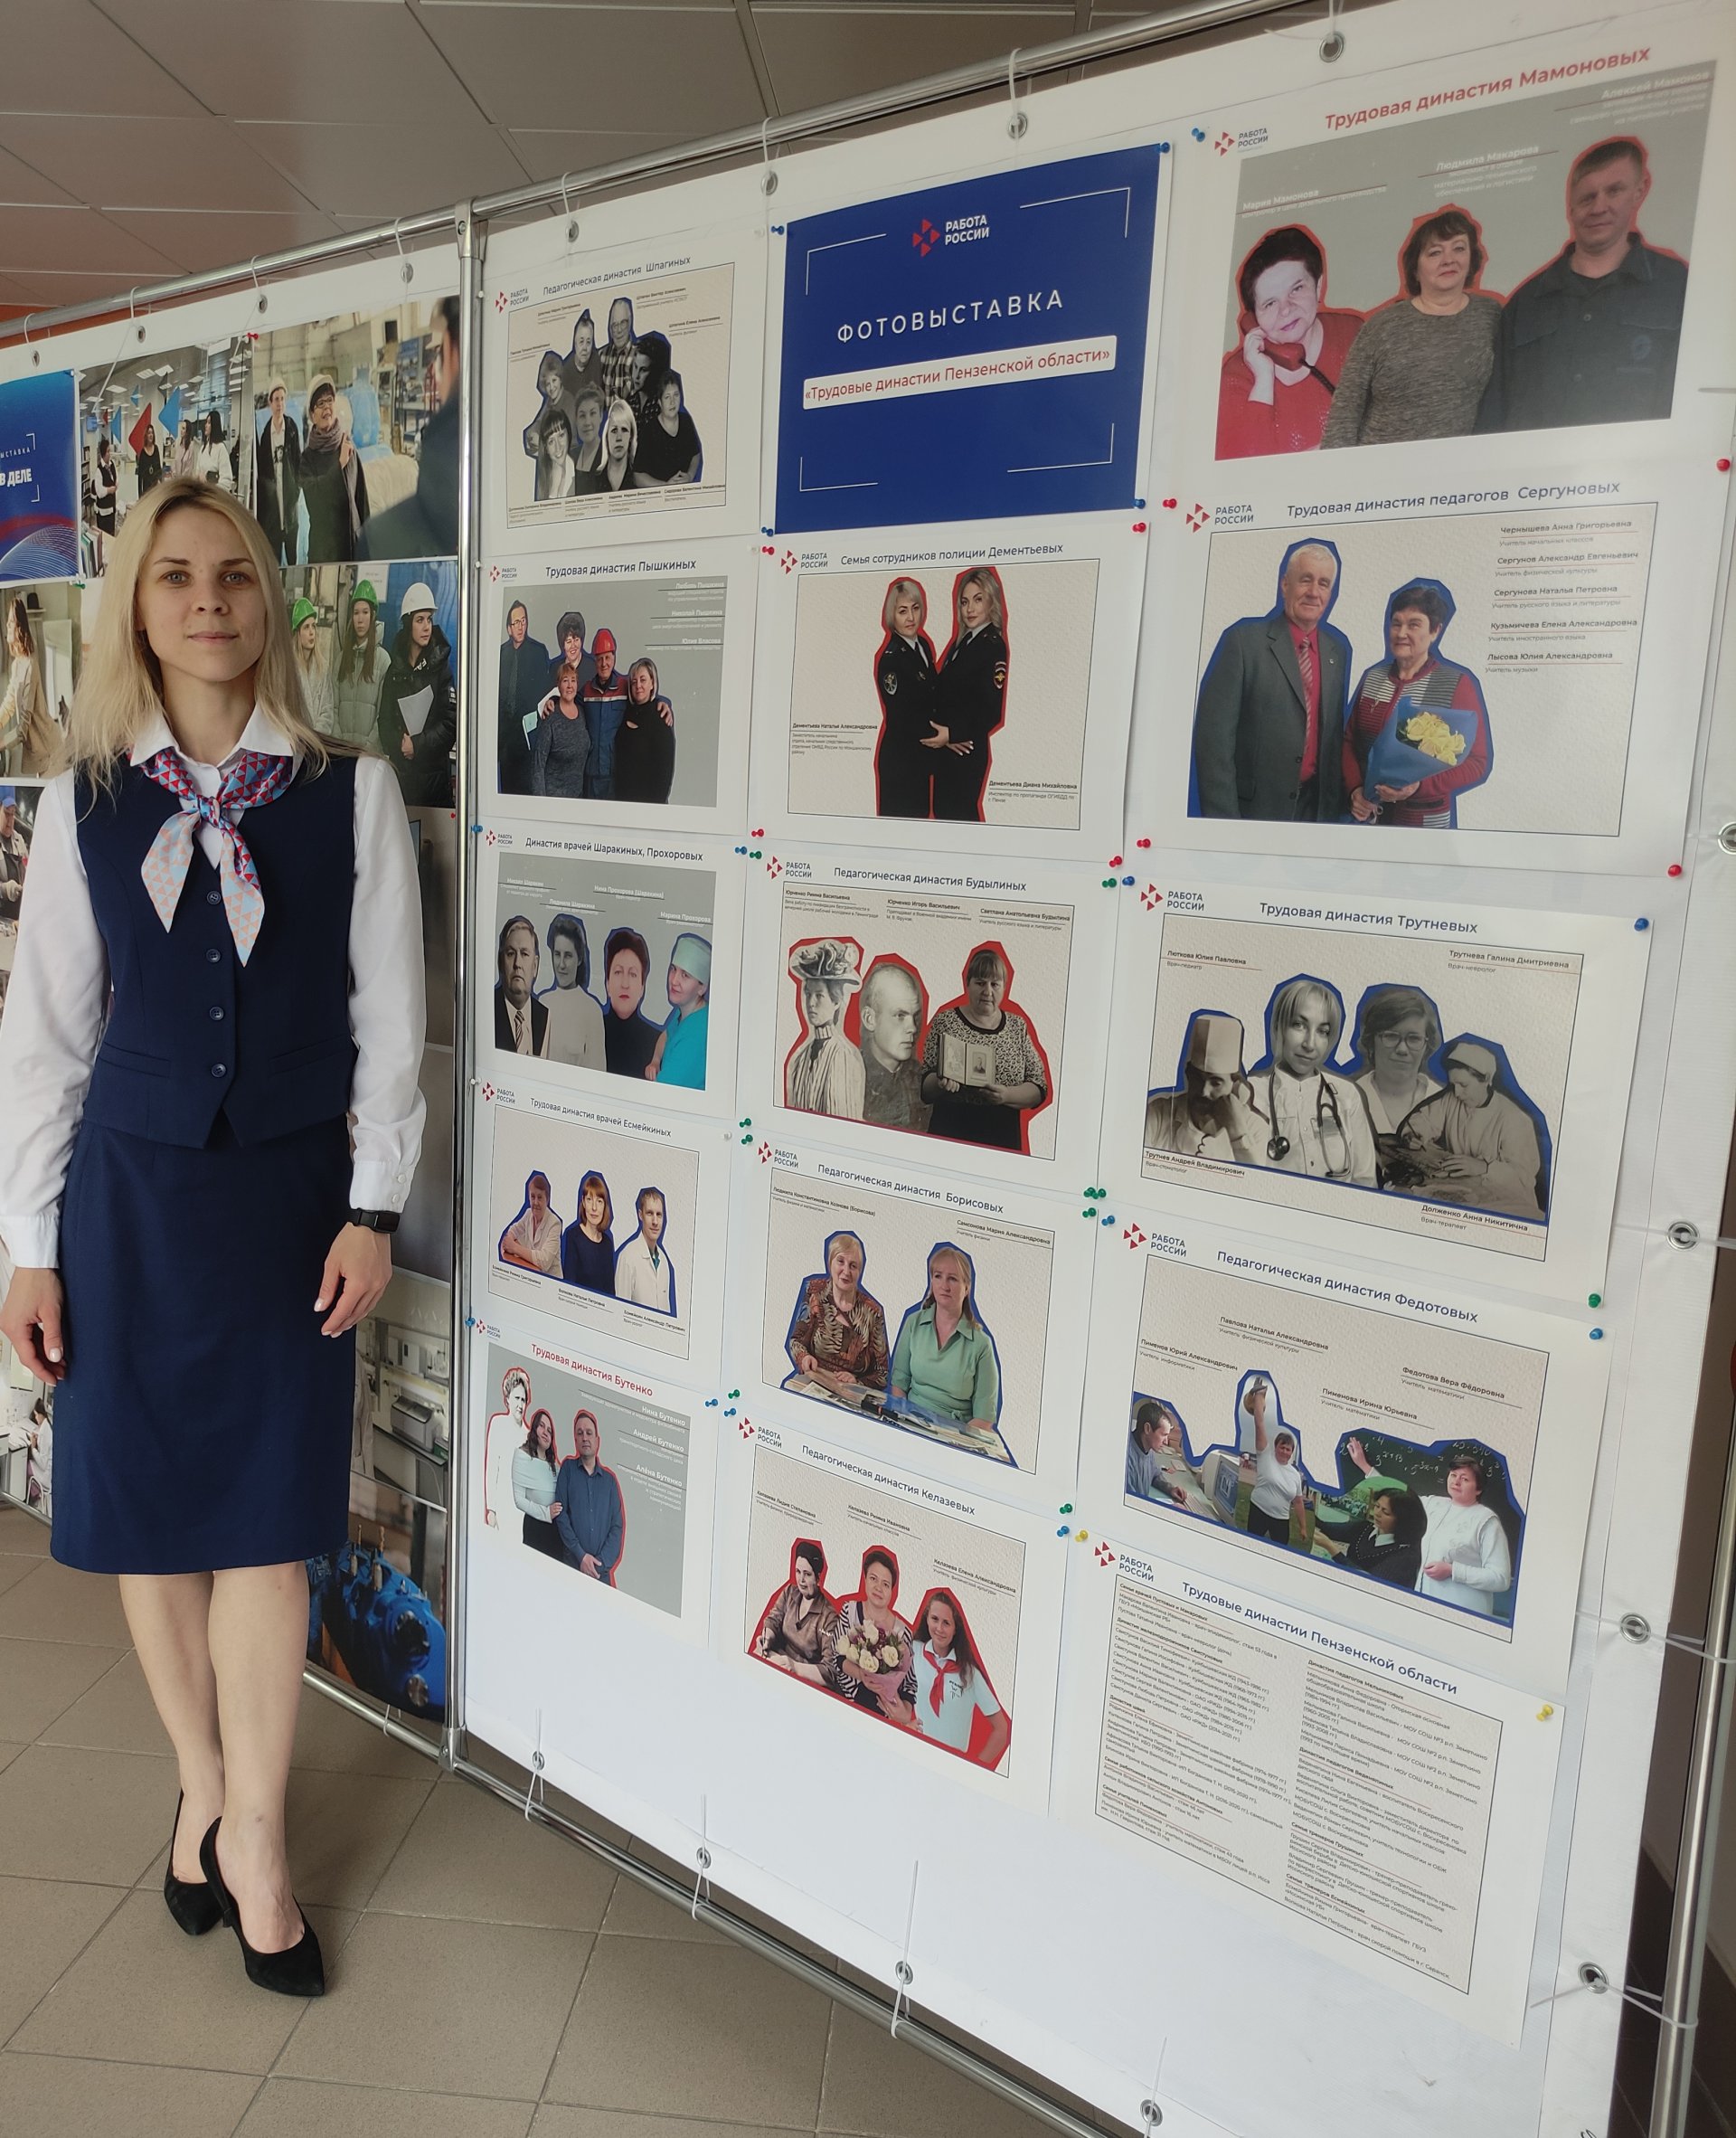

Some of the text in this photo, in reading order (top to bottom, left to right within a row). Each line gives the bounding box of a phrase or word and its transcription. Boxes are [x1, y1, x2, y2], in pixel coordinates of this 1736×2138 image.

[1326, 47, 1651, 129] Трудовая династия Мамоновых
[1238, 136, 1268, 148] РОССИИ
[1239, 128, 1267, 139] РАБОТА
[946, 214, 987, 232] РАБОТА
[945, 228, 989, 245] РОССИИ
[543, 257, 691, 296] Педагогическая династия Шпагиных
[510, 296, 529, 307] РОССИИ
[511, 289, 528, 298] РАБОТА
[837, 290, 1063, 343] ФОТОВЫСТАВКА
[805, 349, 1109, 401] «Трудовые династии Пензенской области»
[7, 468, 33, 487] ДЕЛЕ
[1288, 483, 1620, 518] Трудовая династия педагогов Сергуновых
[1216, 505, 1252, 515] РАБОТА
[1214, 515, 1253, 525] РОССИИ
[1501, 525, 1550, 534] Чернышева
[1576, 521, 1631, 530] Григорьевна
[802, 553, 827, 561] РАБОТА
[841, 544, 1062, 565] Семья сотрудников полиции Дементьевых
[1497, 552, 1638, 564] Сергунов Александр Евгеньевич
[546, 560, 696, 579] Трудовая династия Пышкиных
[801, 561, 828, 569] РОССИИ
[1495, 586, 1617, 597] Сергунова Наталья Петровна
[1491, 622, 1539, 630] Кузьмичева
[1569, 620, 1637, 628] Александровна
[1545, 652, 1612, 661] Александровна
[525, 837, 703, 861] Династия врачей Шаракиных, Прохоровых
[786, 870, 812, 878] РОССИИ
[787, 862, 811, 870] РАБОТА
[834, 868, 1026, 892] Педагогическая династия Будылиных
[1168, 891, 1203, 902] РАБОТА
[1167, 901, 1204, 911] РОССИИ
[1260, 903, 1477, 934] Трудовая династия Трутневых
[1167, 951, 1194, 959] Люткова
[1215, 956, 1246, 964] Павловна
[1449, 950, 1569, 969] Трутнева Галина Дмитриевна
[497, 1088, 514, 1097] РАБОТА
[497, 1095, 515, 1104] РОССИИ
[531, 1098, 671, 1138] Трудовая династия врачей Есмейкиных
[774, 1157, 798, 1168] РОССИИ
[775, 1149, 797, 1160] РАБОТА
[1146, 1151, 1244, 1176] Трутнев Андрей Владимирович
[818, 1164, 1004, 1213] Педагогическая династия Борисовых
[1422, 1205, 1527, 1231] Долженко Анна Никитична
[1150, 1242, 1187, 1257] РОССИИ
[1152, 1233, 1185, 1248] РАБОТА
[1217, 1251, 1478, 1323] Педагогическая династия Федотовых
[487, 1324, 500, 1333] РАБОТА
[1221, 1317, 1328, 1350] Павлова Наталья Александровна
[1141, 1339, 1238, 1371] Пименов Юрий Александрович
[532, 1344, 653, 1396] Трудовая династия Бутенко
[1403, 1367, 1505, 1399] Федотова Вера Фёдоровна
[1323, 1388, 1417, 1420] Пименова Ирина Юрьевна
[642, 1405, 657, 1417] Нина
[660, 1413, 685, 1426] Бутенко
[633, 1429, 656, 1443] Андрей
[658, 1438, 684, 1452] Бутенко
[757, 1433, 782, 1448] РОССИИ
[759, 1426, 781, 1440] РАБОТА
[802, 1445, 975, 1515] Педагогическая династия Келазевых
[1119, 1555, 1153, 1574] РАБОТА
[1119, 1563, 1154, 1583] РОССИИ
[1183, 1582, 1457, 1694] Трудовые династии Пензенской области
